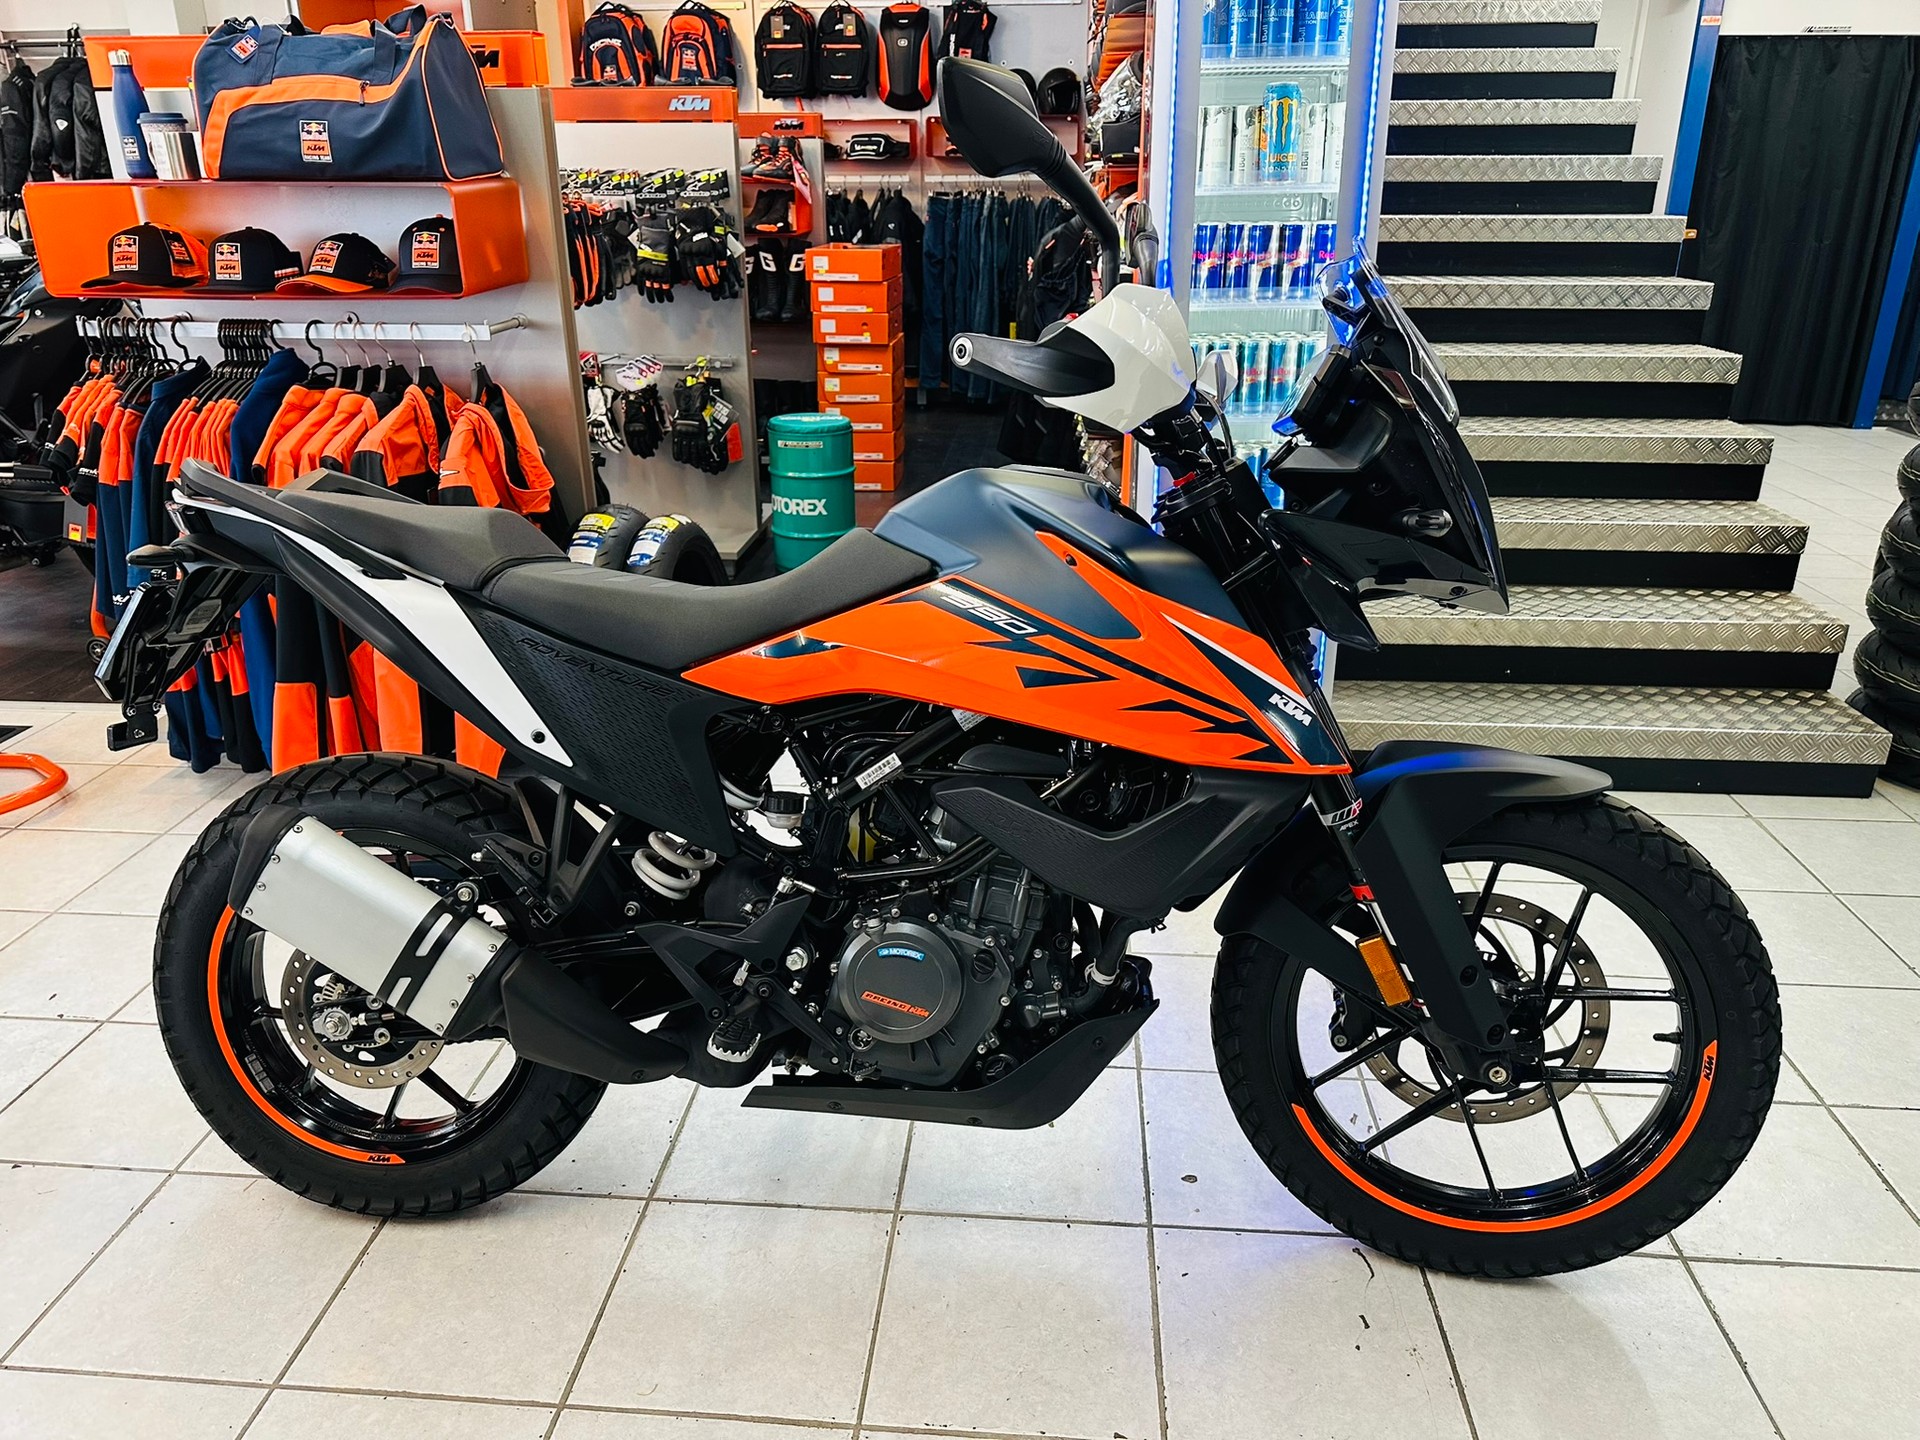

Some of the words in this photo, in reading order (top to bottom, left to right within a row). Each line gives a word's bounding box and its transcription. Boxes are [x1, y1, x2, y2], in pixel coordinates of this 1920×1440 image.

[470, 44, 500, 68] TM
[668, 95, 711, 111] KTM
[773, 118, 804, 131] KTM
[307, 144, 325, 152] KTM
[758, 250, 777, 272] G
[1319, 250, 1336, 260] Red
[771, 494, 828, 516] OTOREX
[939, 593, 1039, 634] 390
[515, 637, 677, 698] ADVENTURE
[1268, 692, 1312, 727] KTM
[1330, 798, 1363, 826] WP
[1339, 820, 1359, 831] APEX
[889, 947, 924, 960] MOTOREX
[865, 993, 907, 1011] RACING
[1703, 1055, 1715, 1082] KTM
[367, 1153, 392, 1163] KTM
